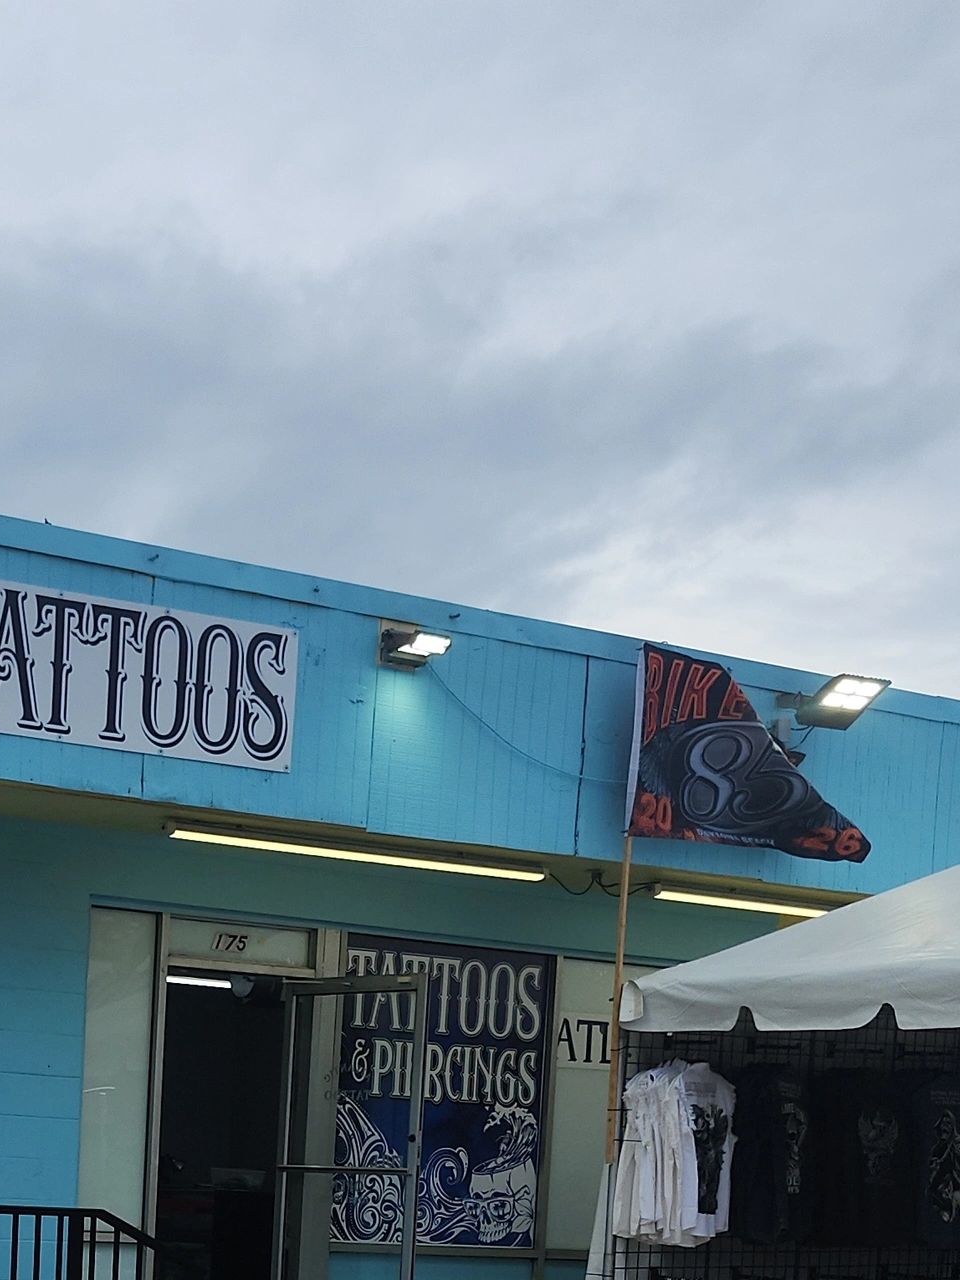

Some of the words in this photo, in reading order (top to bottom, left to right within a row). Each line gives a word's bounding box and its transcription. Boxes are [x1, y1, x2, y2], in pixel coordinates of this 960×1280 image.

[214, 933, 248, 952] 175
[346, 949, 541, 1042] TATTOOS
[351, 1039, 370, 1082] &
